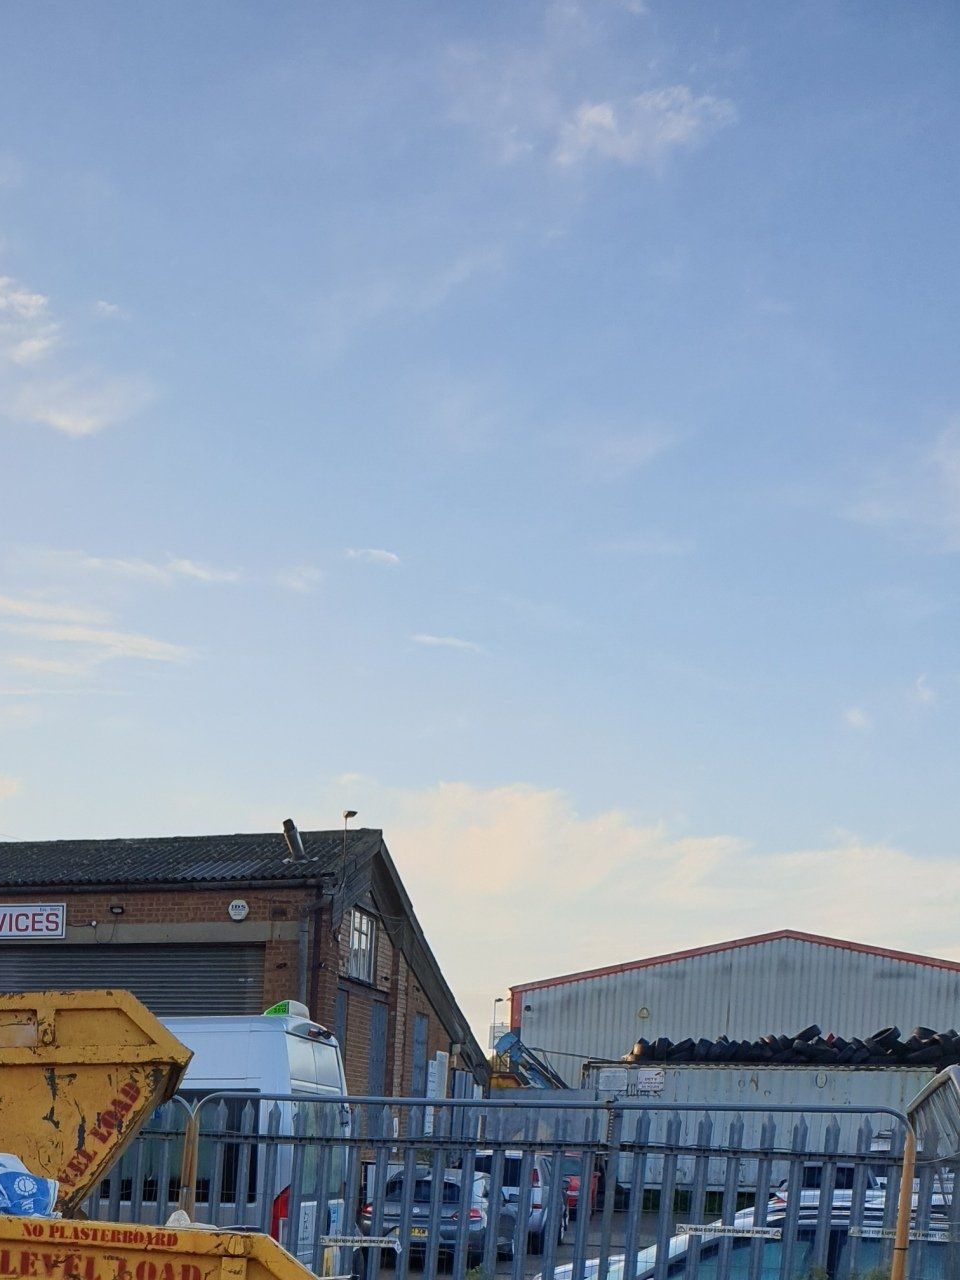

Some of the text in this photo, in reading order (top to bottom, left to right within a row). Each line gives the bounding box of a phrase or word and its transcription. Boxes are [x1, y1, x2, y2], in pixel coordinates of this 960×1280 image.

[86, 1081, 141, 1144] LOAD
[22, 1222, 179, 1247] NO PLASTERBOARD
